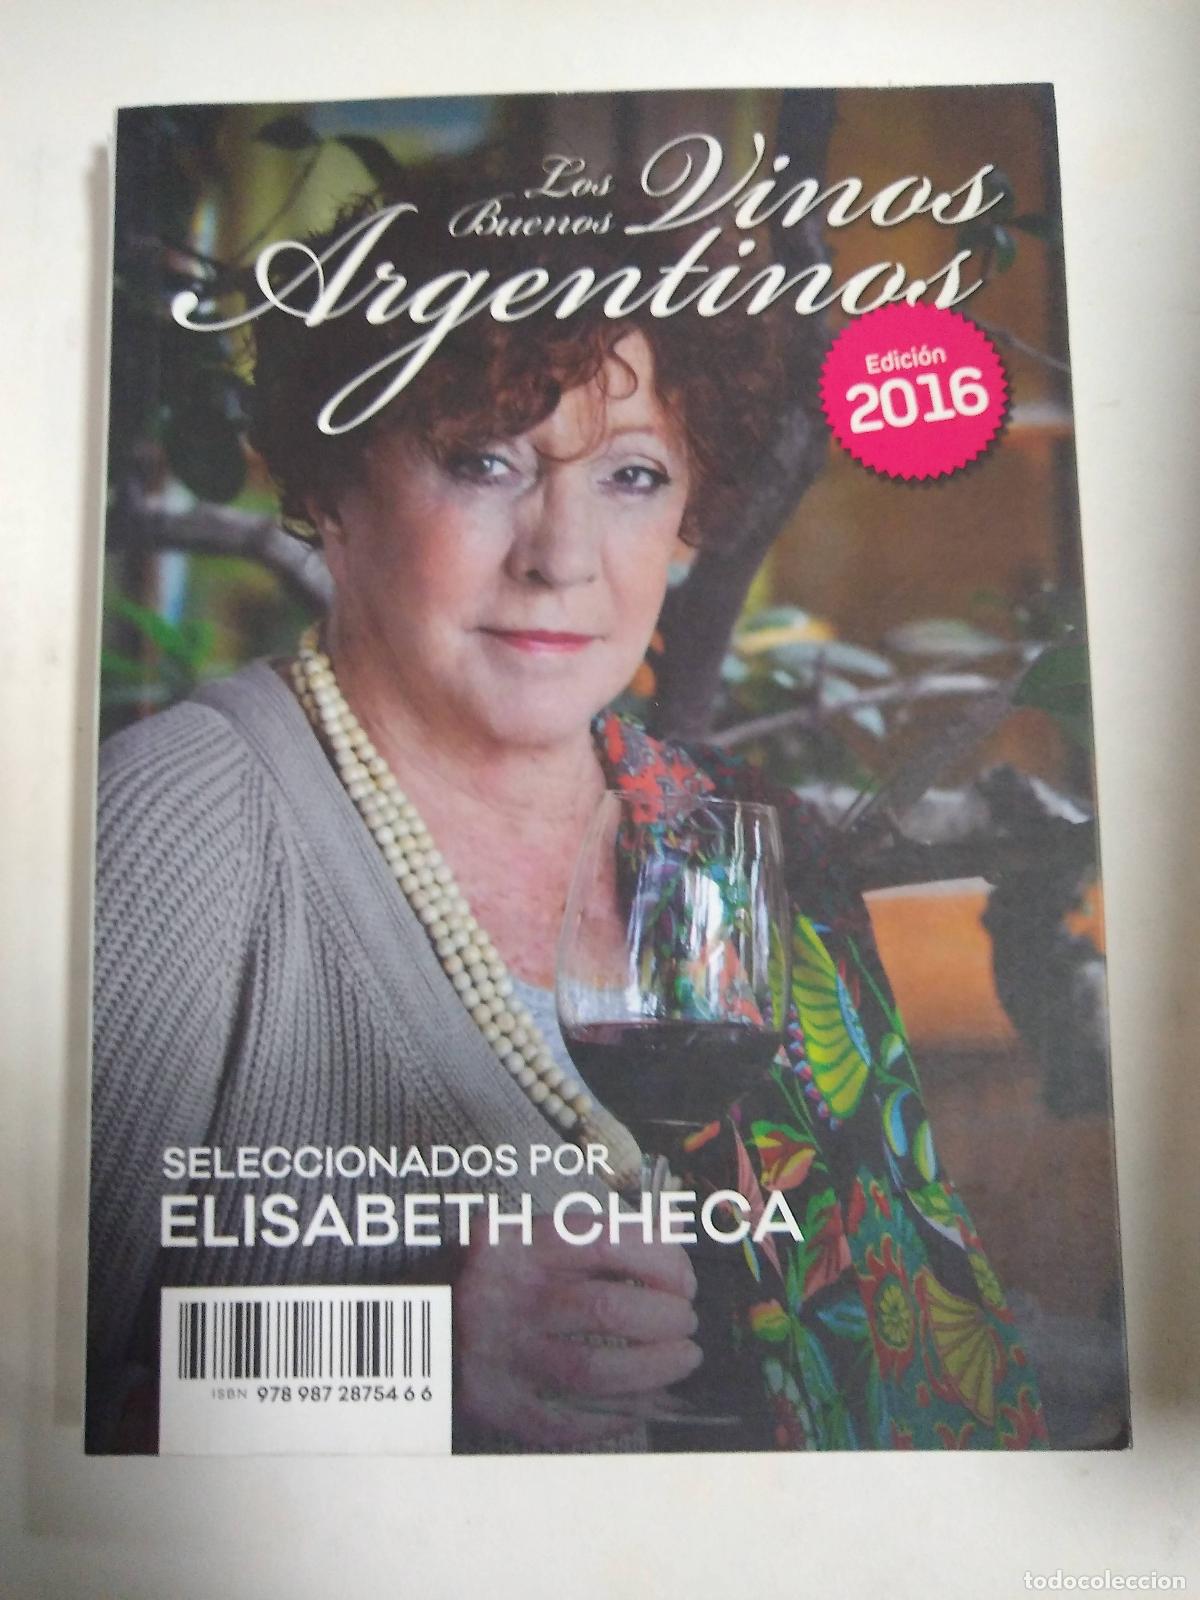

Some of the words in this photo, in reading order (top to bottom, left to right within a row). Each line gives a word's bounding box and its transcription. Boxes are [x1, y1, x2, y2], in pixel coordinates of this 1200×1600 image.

[524, 154, 613, 198] Los
[624, 131, 1004, 236] Vinos
[448, 193, 613, 237] Buenos
[170, 203, 984, 435] Argentinos
[865, 344, 947, 375] Edición
[845, 366, 990, 434] 2016
[162, 1144, 519, 1180] SELECCIONADOS
[530, 1144, 616, 1177] POR
[161, 1191, 533, 1248] ELISABETH
[552, 1190, 805, 1244] CHECA
[211, 1387, 248, 1400] ISBN
[257, 1386, 292, 1402] 978
[298, 1386, 332, 1402] 987
